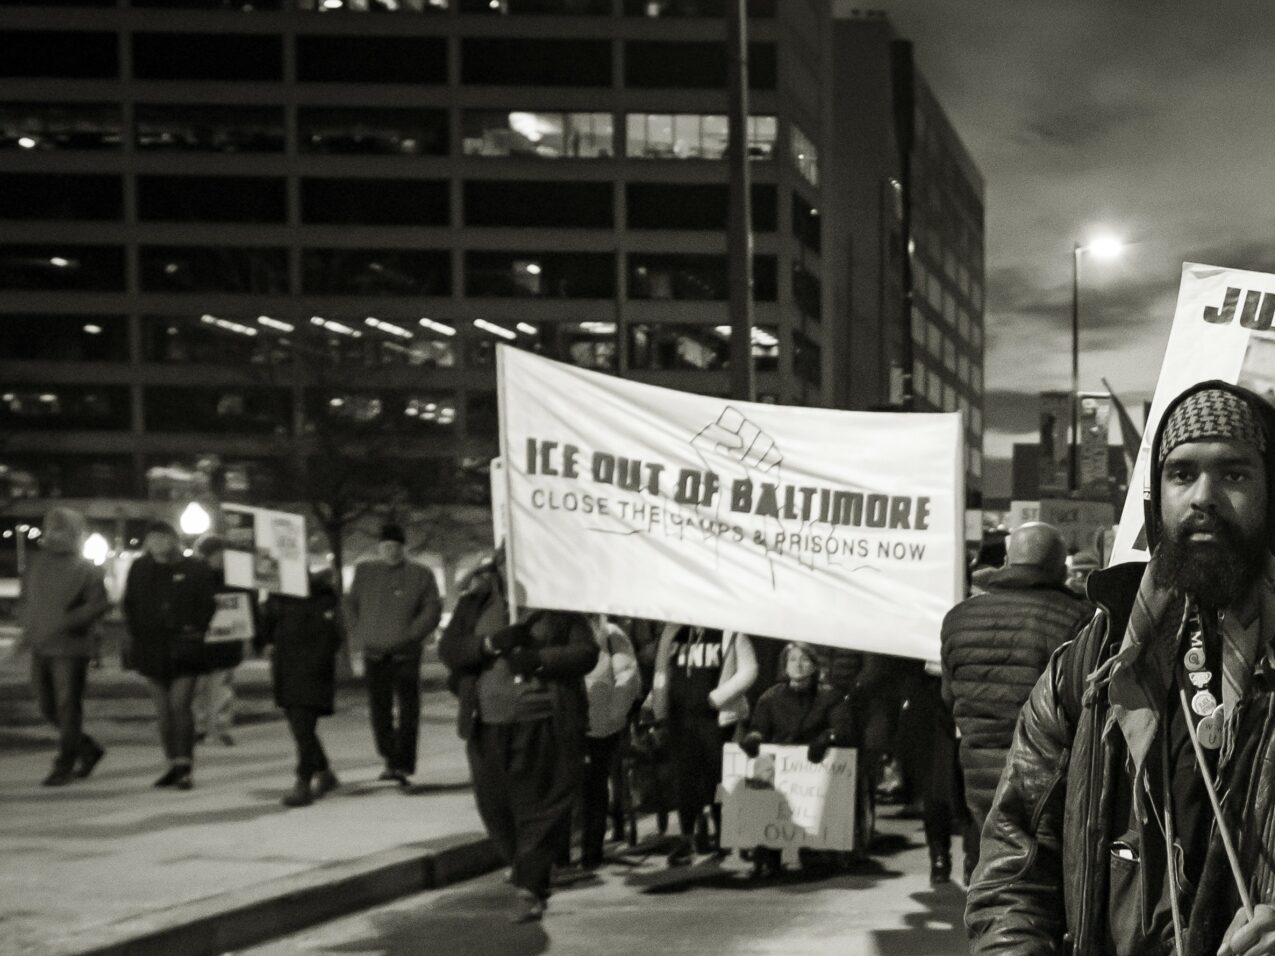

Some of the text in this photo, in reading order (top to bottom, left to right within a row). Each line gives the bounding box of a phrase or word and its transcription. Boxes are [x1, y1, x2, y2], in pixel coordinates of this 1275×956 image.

[527, 438, 930, 530] ICE OUT OF BALTIMORE
[532, 489, 610, 515] CLOSE
[618, 501, 660, 523] THE
[753, 530, 767, 548] &
[774, 532, 869, 560] PRISONS
[877, 541, 926, 561] NOW
